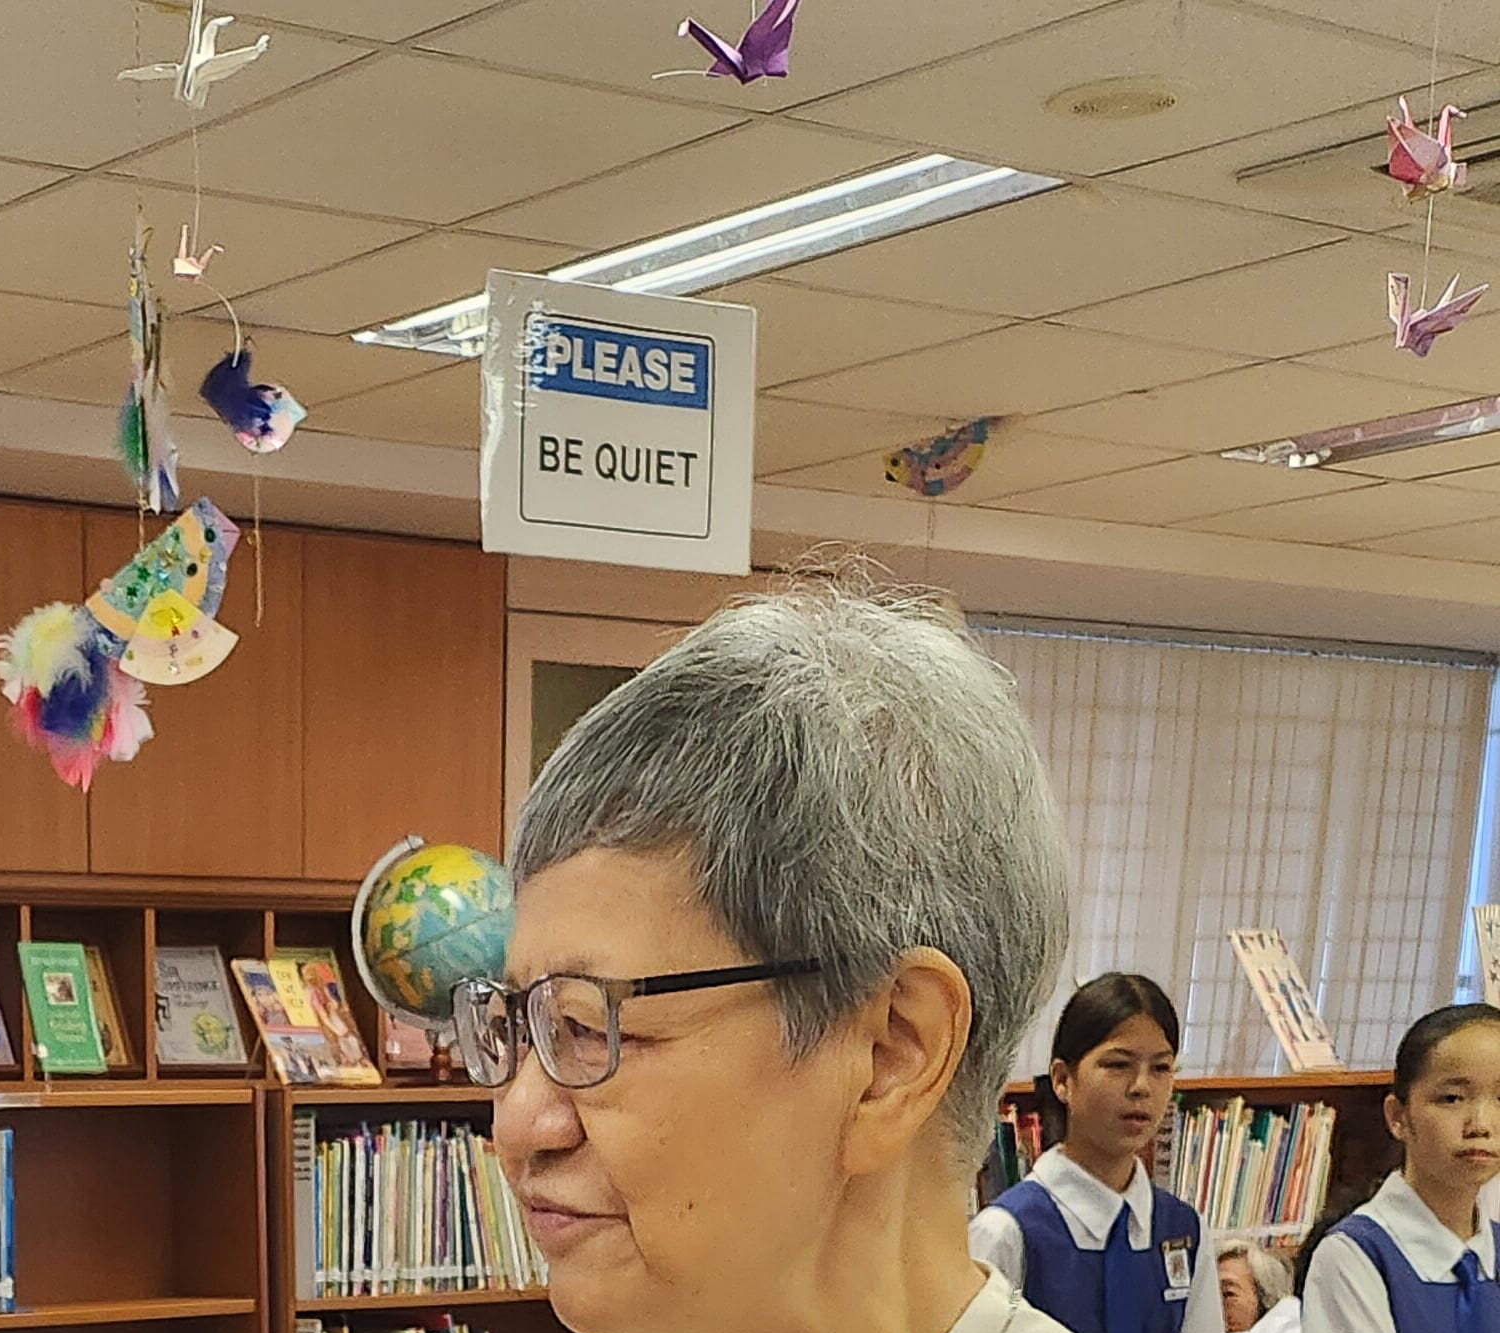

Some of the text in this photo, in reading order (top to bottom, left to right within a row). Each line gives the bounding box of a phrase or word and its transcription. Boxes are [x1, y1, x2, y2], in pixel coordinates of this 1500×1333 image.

[544, 333, 696, 395] PLEASE
[539, 436, 698, 487] BE QUIET
